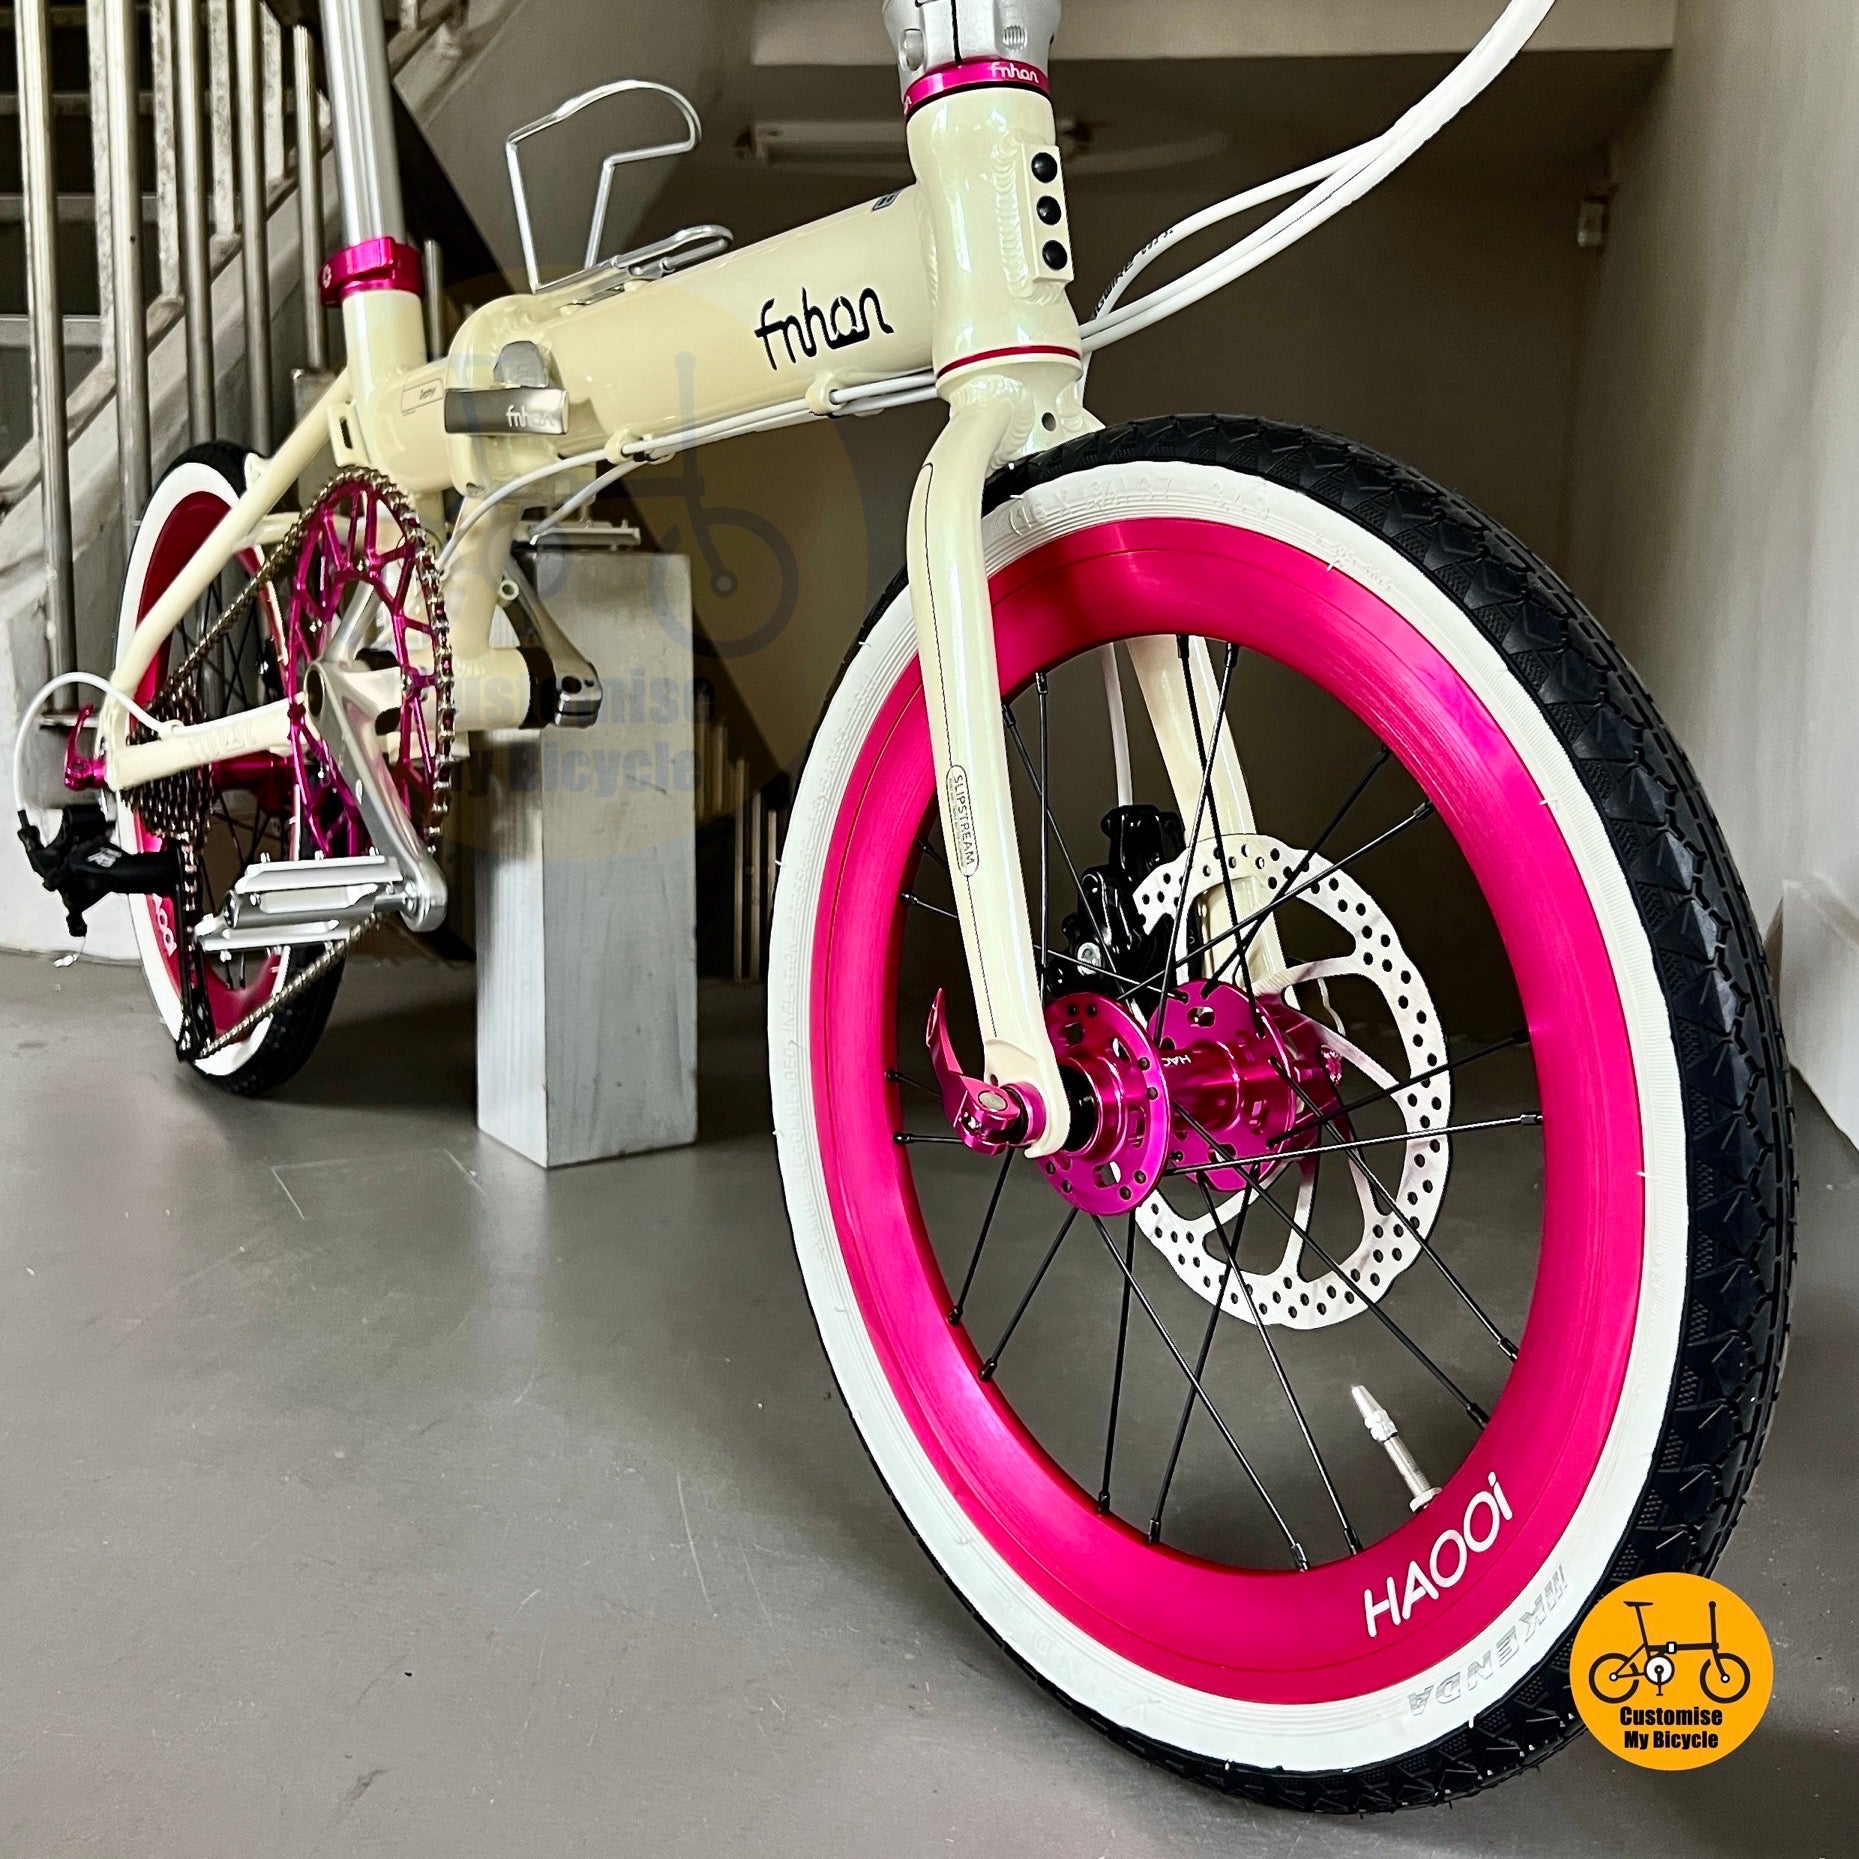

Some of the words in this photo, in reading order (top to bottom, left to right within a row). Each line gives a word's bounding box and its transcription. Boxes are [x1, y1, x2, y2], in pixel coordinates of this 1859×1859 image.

[989, 62, 1040, 84] fnhan
[754, 286, 895, 371] fnhan
[953, 774, 976, 866] SLIPSTREAM
